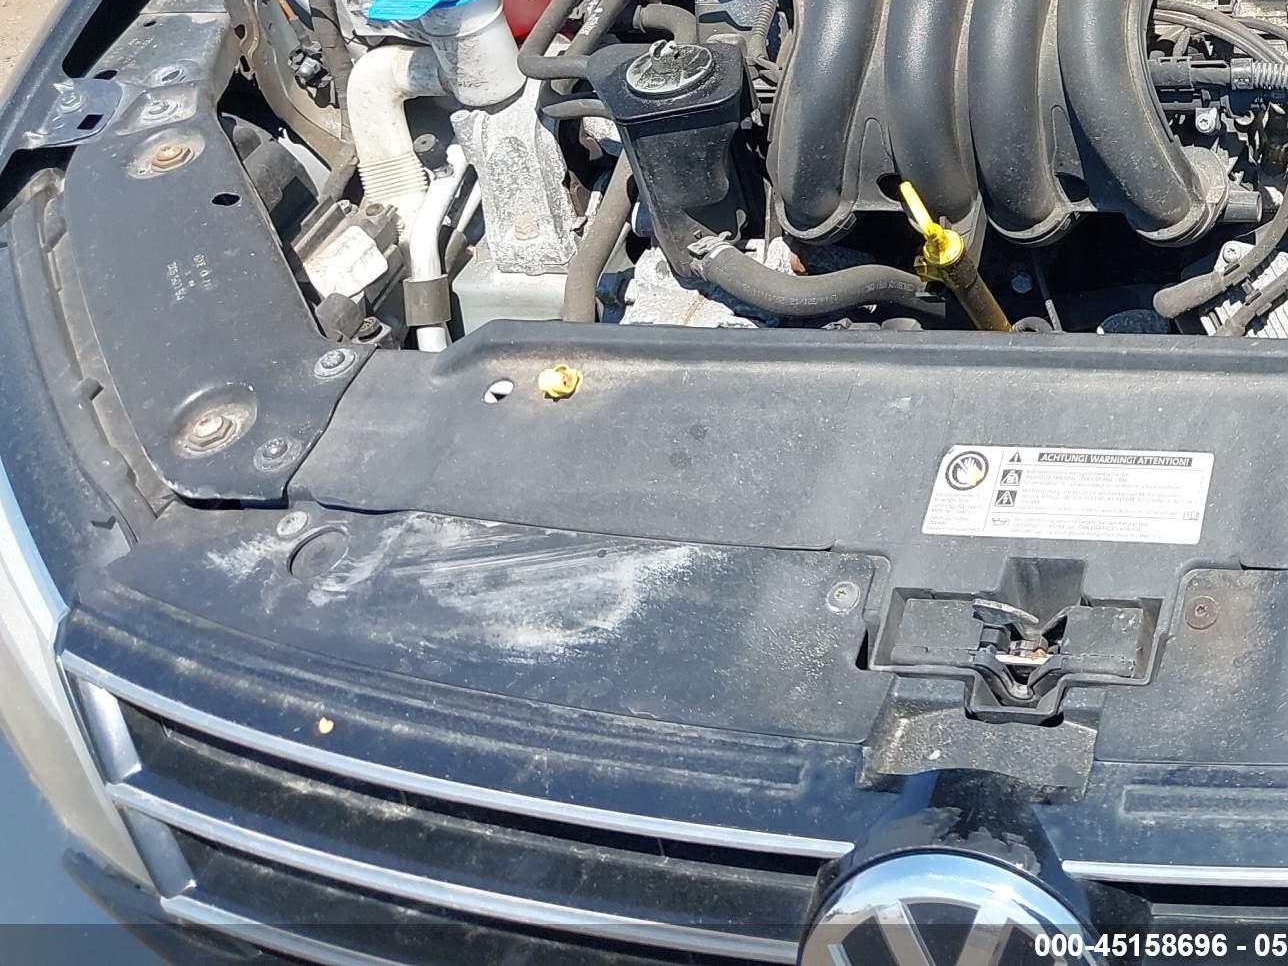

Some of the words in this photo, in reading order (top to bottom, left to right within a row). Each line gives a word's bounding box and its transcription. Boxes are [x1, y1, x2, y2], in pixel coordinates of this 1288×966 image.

[1041, 453, 1088, 463] ACHTUNG!
[1090, 455, 1137, 465] WARNING!
[1137, 457, 1190, 467] ATTENTION!
